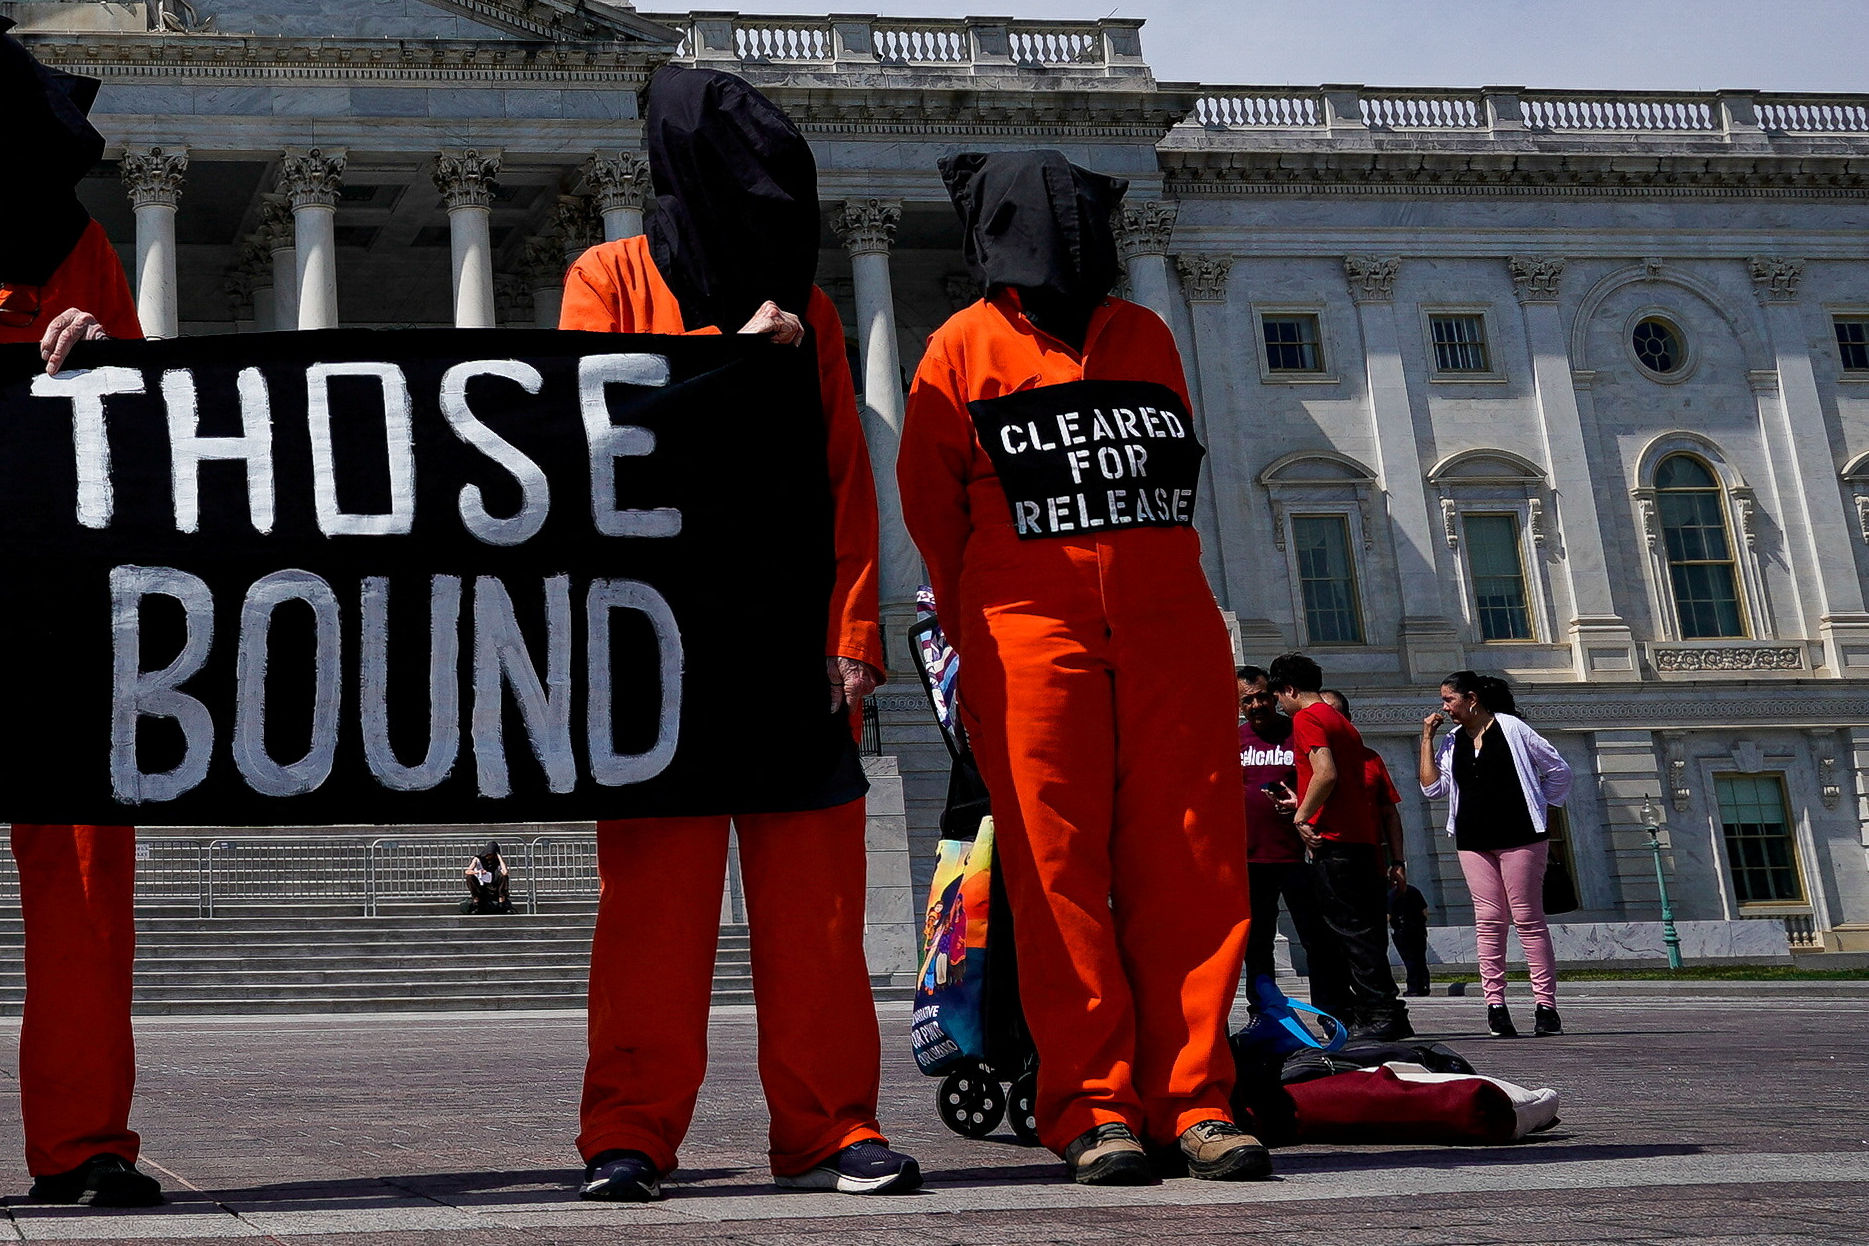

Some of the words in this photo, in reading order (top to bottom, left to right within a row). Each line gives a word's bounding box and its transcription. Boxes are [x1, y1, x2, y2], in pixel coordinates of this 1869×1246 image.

[30, 353, 681, 545] THOSE
[1000, 407, 1185, 454] CLEARED
[1067, 445, 1147, 484] FOR
[1015, 488, 1192, 534] RELEASE
[109, 564, 684, 804] BOUND
